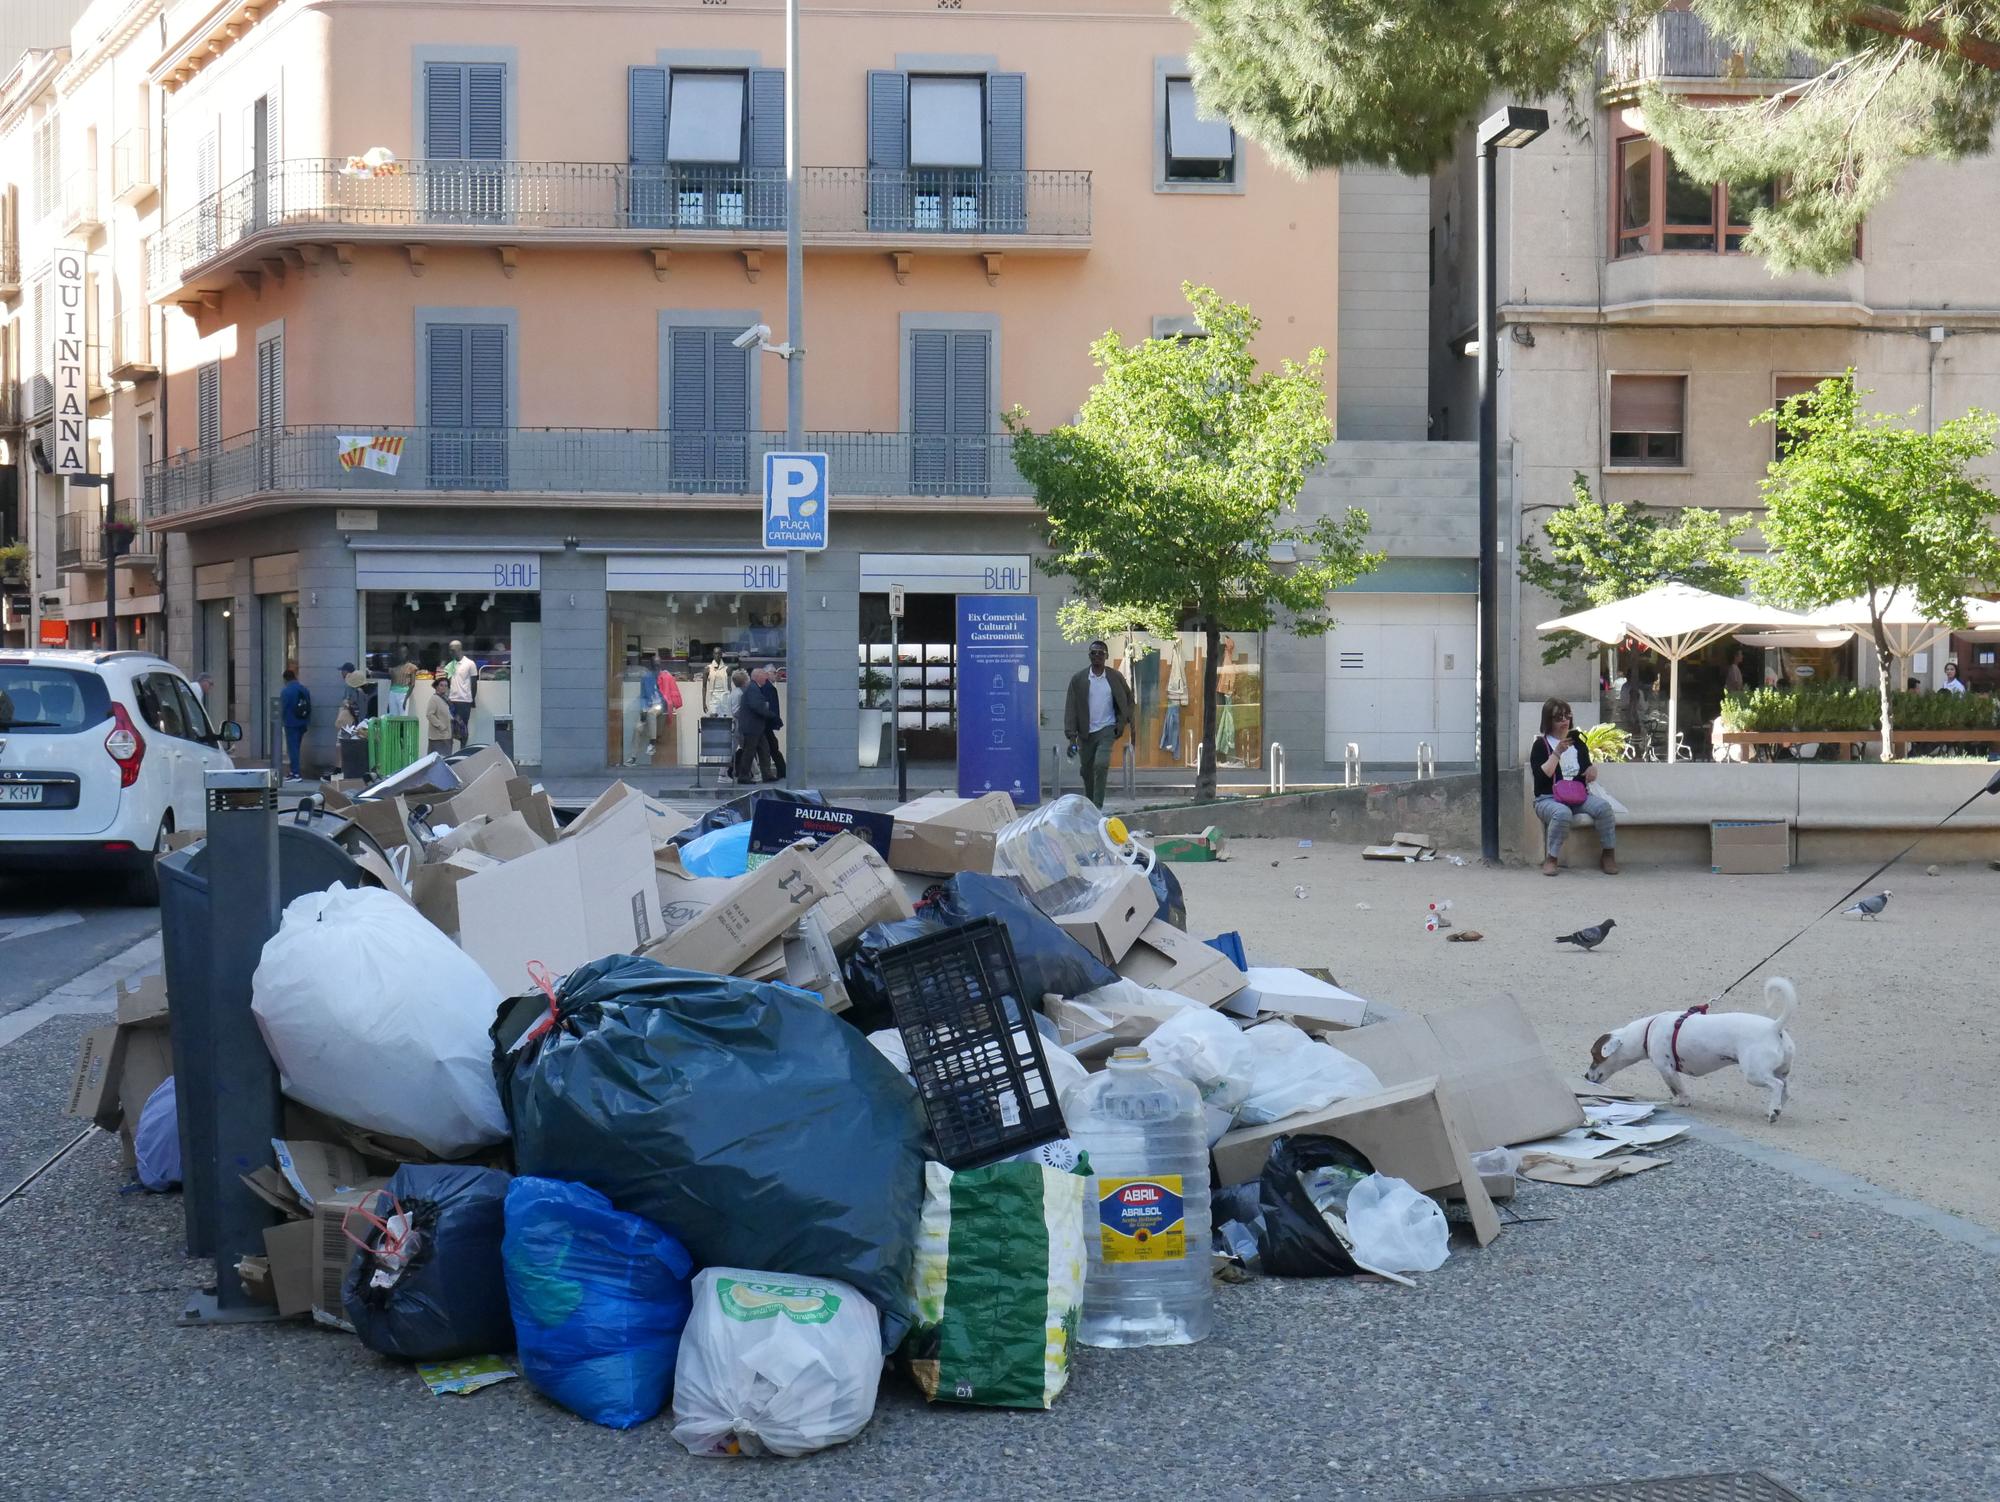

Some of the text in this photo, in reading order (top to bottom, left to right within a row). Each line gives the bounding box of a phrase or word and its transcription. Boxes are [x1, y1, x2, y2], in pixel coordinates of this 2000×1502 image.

[58, 256, 83, 469] QUINTANA
[769, 456, 818, 520] P
[780, 520, 810, 531] PLAÇA
[768, 531, 822, 541] CATALUNYA
[494, 563, 532, 588] BLAU
[743, 564, 781, 589] BLAU
[984, 566, 1021, 591] BLAU
[967, 612, 1028, 622] Eix Comercial,
[978, 622, 1012, 631] Cultural
[794, 807, 854, 824] PAULANER
[1123, 1188, 1159, 1202] ABRIL
[1121, 1206, 1162, 1217] ABRILSOL
